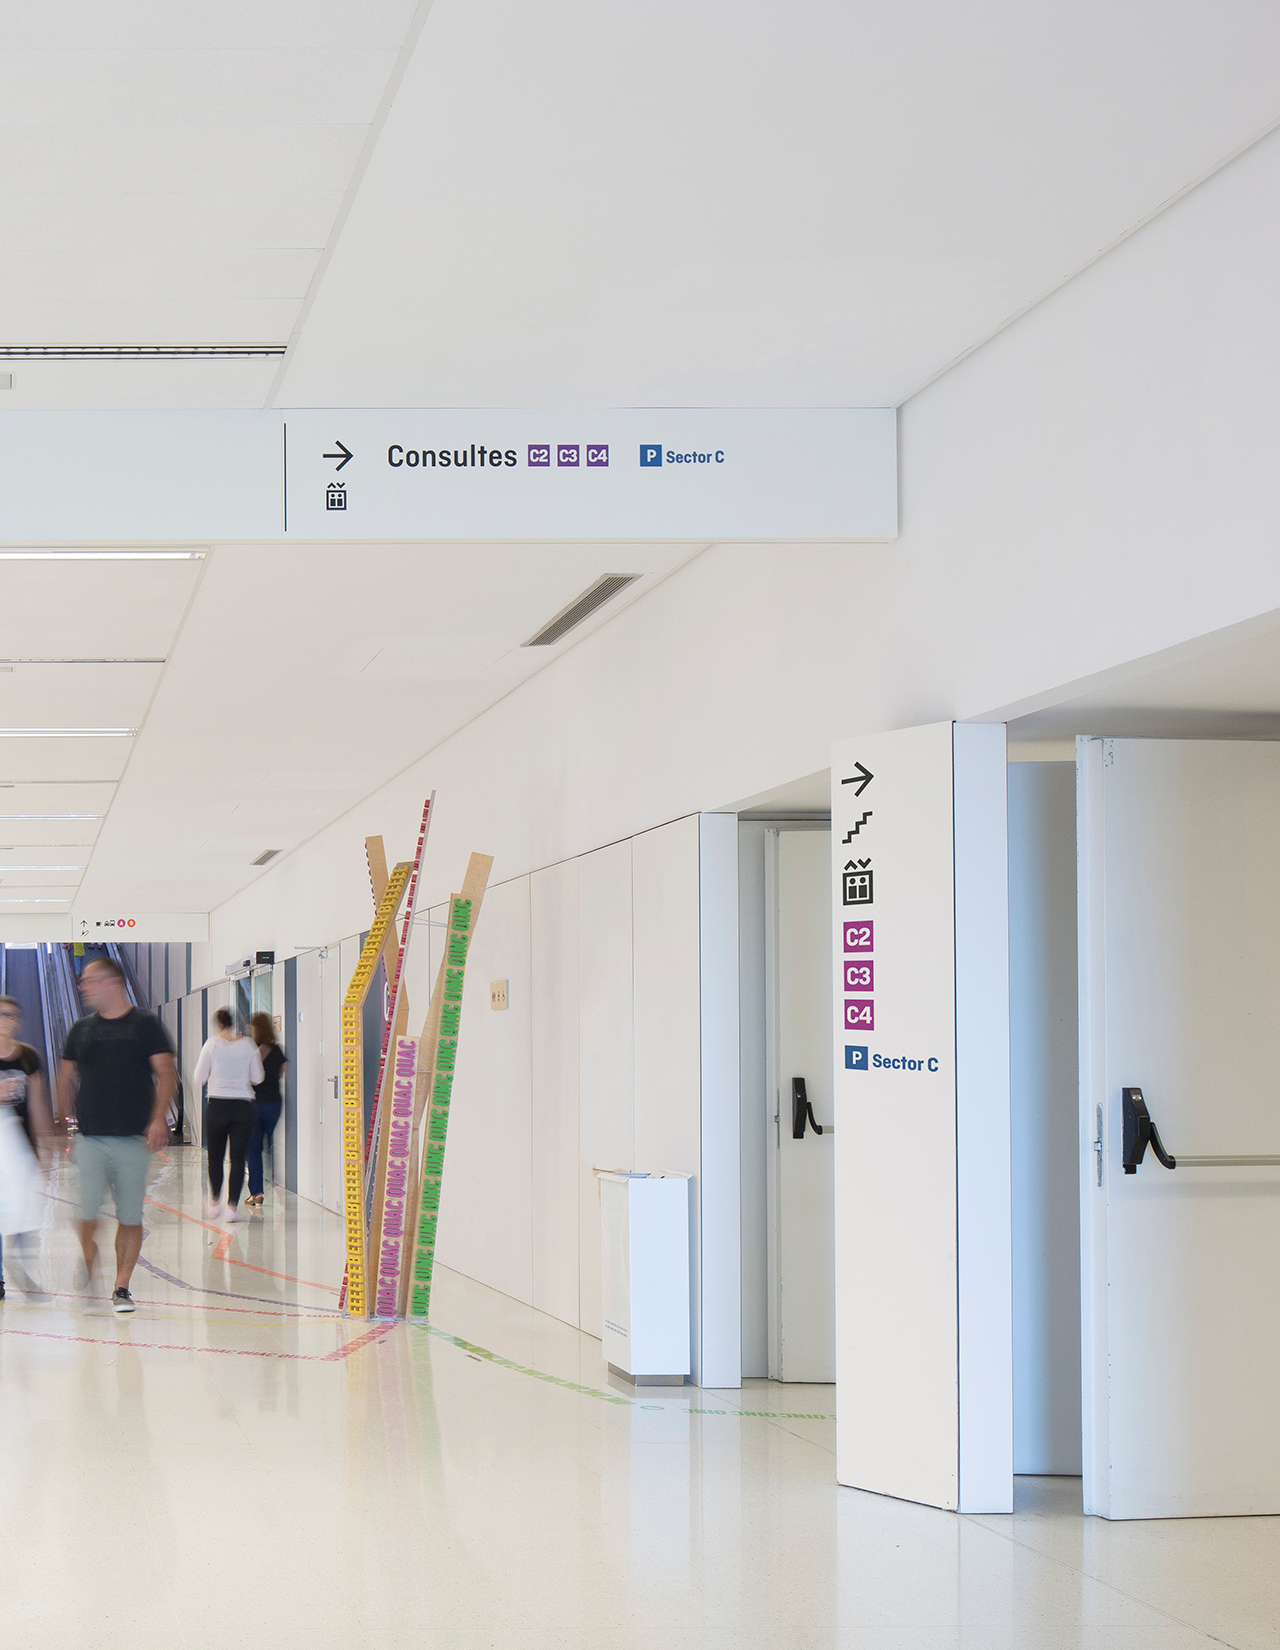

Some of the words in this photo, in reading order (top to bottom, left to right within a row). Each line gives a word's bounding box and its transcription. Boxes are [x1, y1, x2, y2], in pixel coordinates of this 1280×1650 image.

[388, 443, 518, 468] Consultes
[529, 448, 549, 463] C2
[559, 448, 578, 463] C3
[587, 448, 608, 463] C4
[646, 448, 658, 463] P
[666, 450, 713, 464] Sector
[714, 450, 725, 464] C
[451, 898, 472, 931] OINC
[447, 933, 469, 967] OINC
[845, 926, 872, 947] C2
[444, 968, 465, 1002] OINC
[846, 966, 872, 985] C3
[439, 1004, 461, 1037] OINC
[846, 1005, 873, 1025] C4
[395, 1039, 417, 1078] QUAC
[436, 1039, 457, 1072] OINC
[851, 1050, 863, 1065] P
[872, 1053, 925, 1071] Sector
[927, 1057, 939, 1073] C
[392, 1080, 414, 1118] QUAC
[432, 1073, 454, 1107] OINC
[389, 1120, 411, 1158] QUAC
[428, 1109, 449, 1142] OINC
[424, 1144, 445, 1177] OINC
[386, 1160, 408, 1198] QUAC
[421, 1179, 442, 1212] OINC
[382, 1200, 405, 1238] QUAC
[417, 1214, 438, 1247] OINC
[379, 1239, 401, 1278] QUAC
[413, 1249, 435, 1282] OINC
[376, 1277, 399, 1318] QUAC
[411, 1284, 431, 1317] OINC
